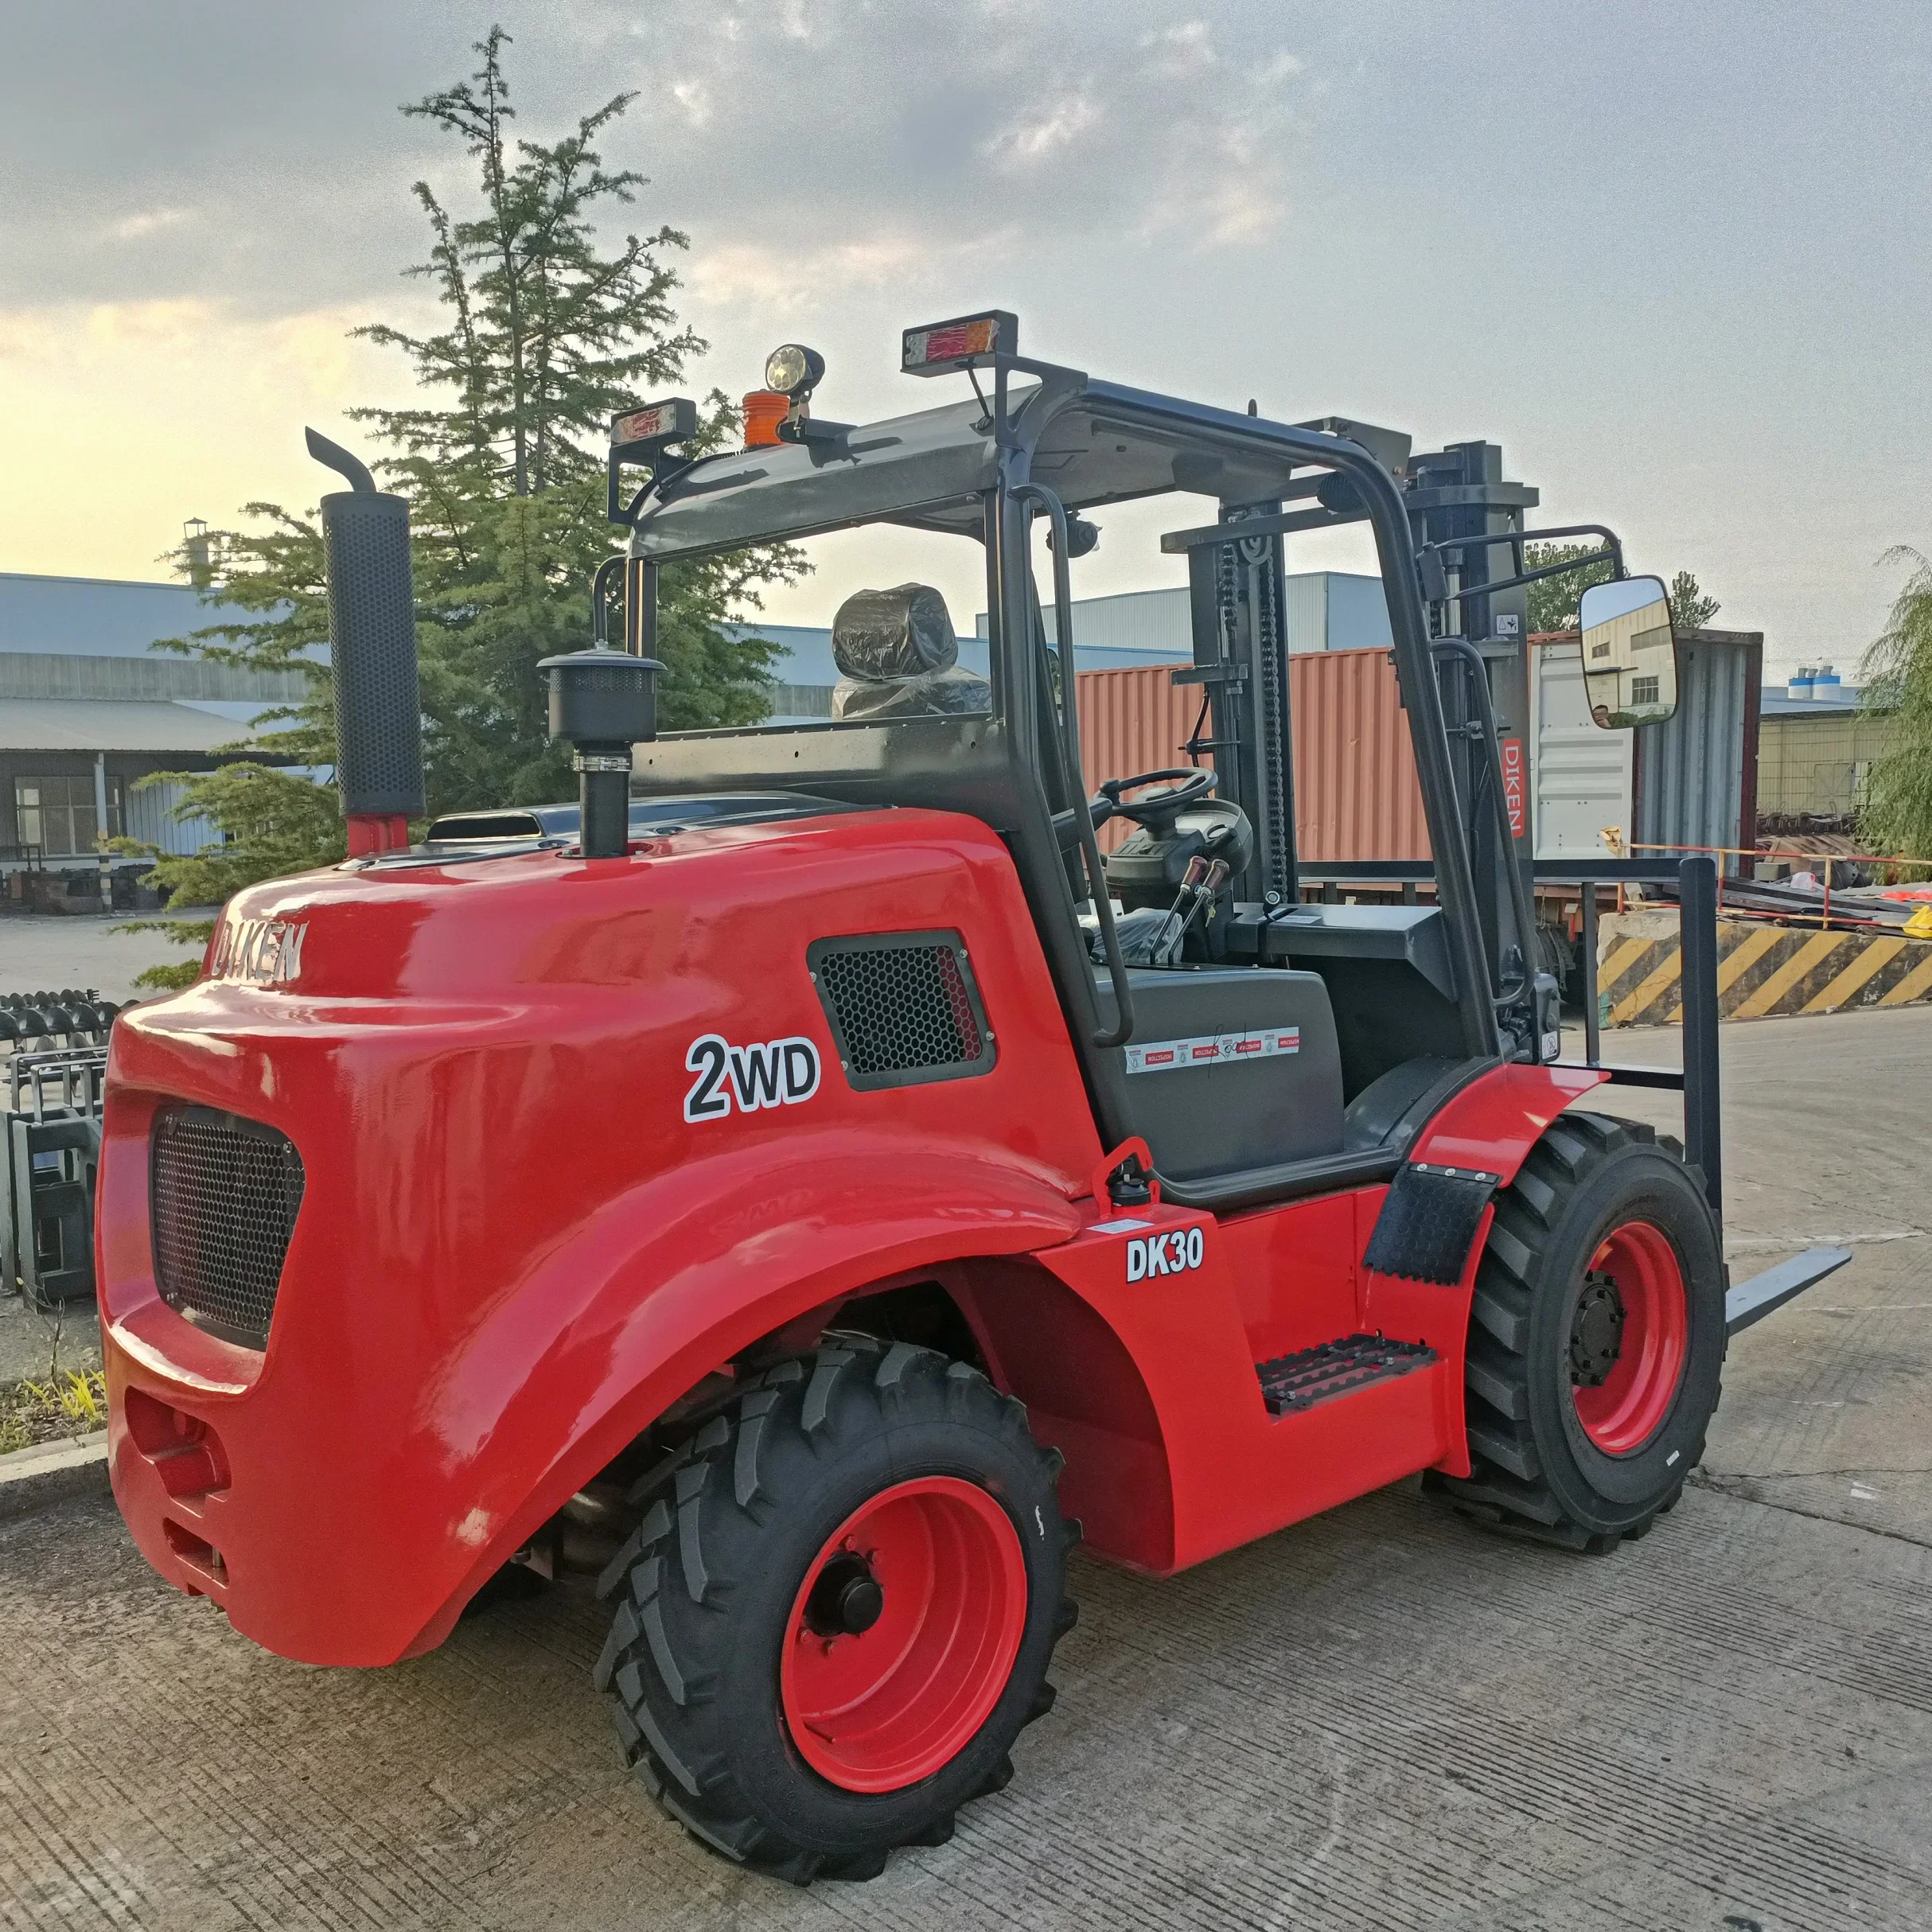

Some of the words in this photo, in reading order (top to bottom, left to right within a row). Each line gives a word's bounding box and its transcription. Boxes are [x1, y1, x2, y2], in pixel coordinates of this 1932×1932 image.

[1505, 746, 1521, 831] DIKEN
[212, 921, 309, 981] DIKEN
[688, 1039, 816, 1117] 2WD
[1126, 1227, 1204, 1283] DK30
